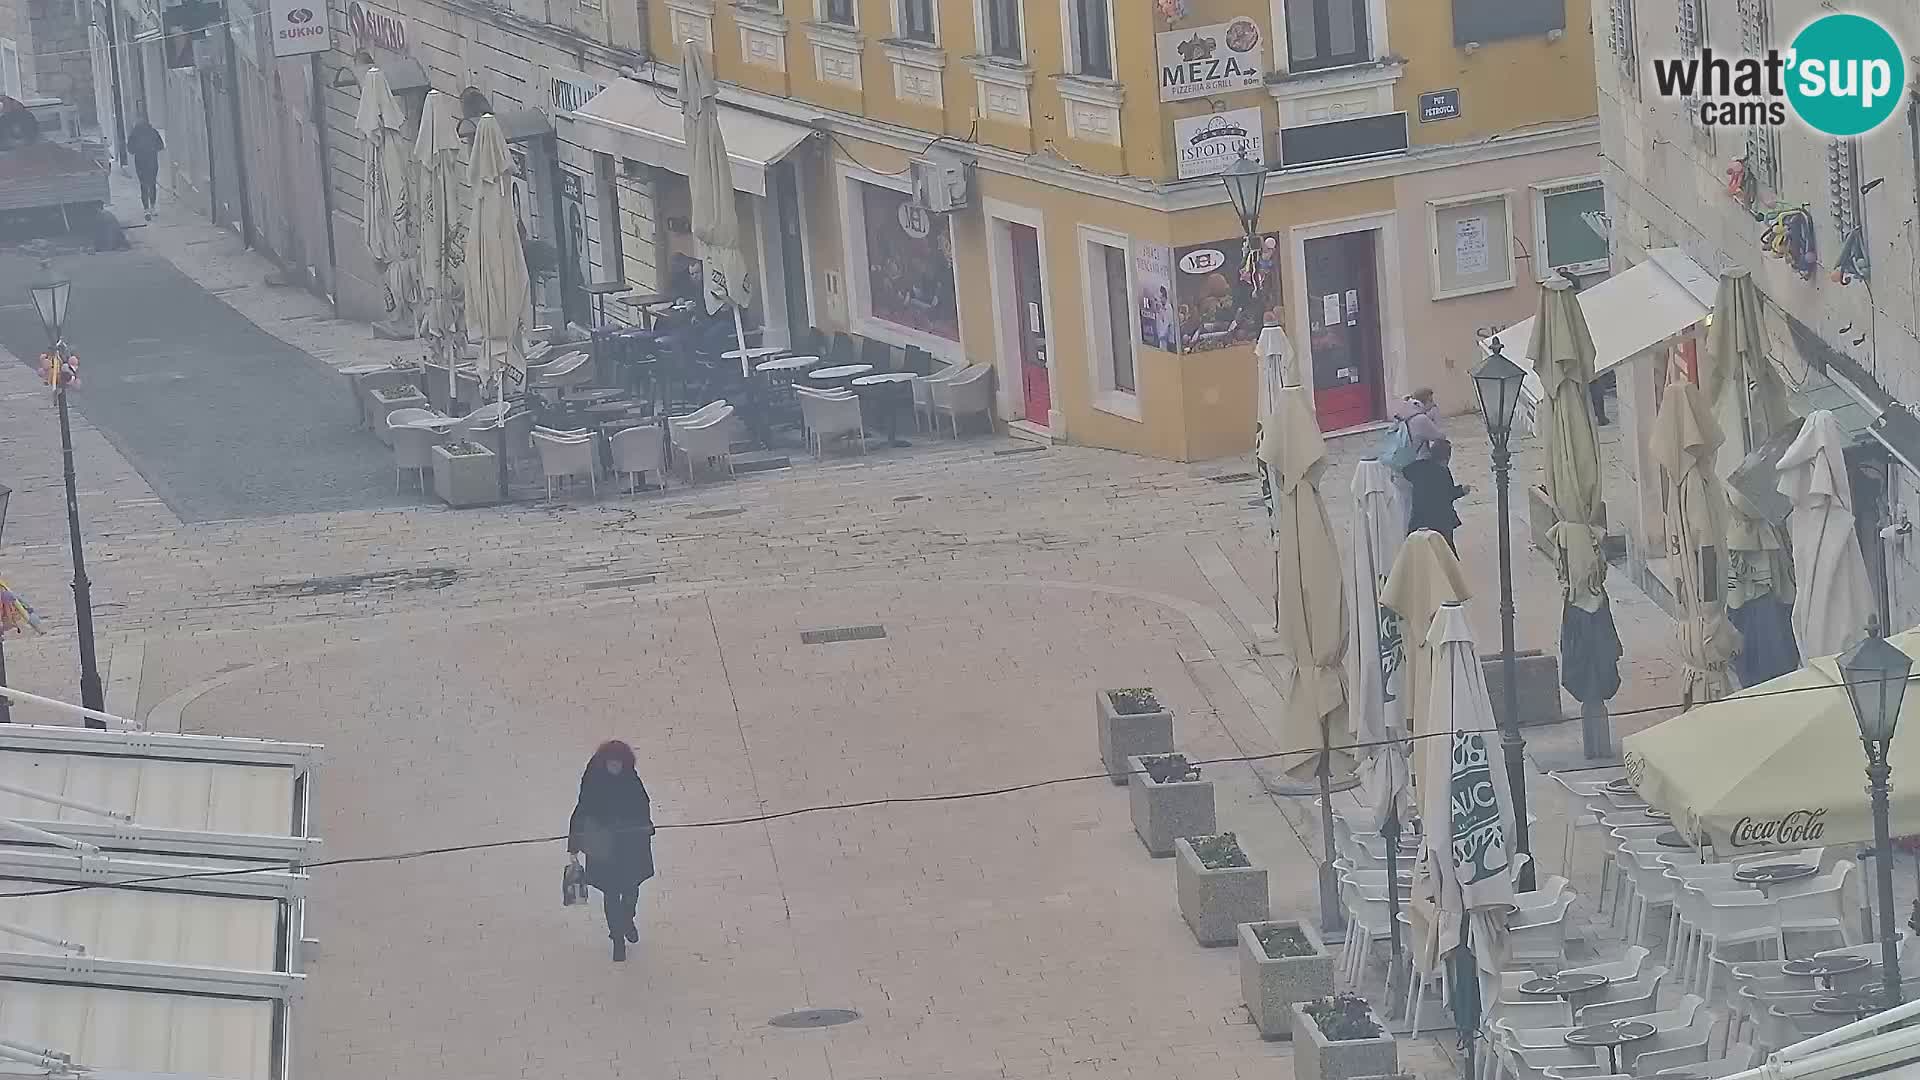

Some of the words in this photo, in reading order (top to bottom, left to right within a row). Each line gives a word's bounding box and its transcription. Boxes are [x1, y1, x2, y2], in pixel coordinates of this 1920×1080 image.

[280, 25, 324, 39] SUKNO
[366, 9, 405, 49] SUKNO
[1163, 57, 1241, 87] MEZA
[1172, 83, 1204, 94] PIZZERIA
[1212, 80, 1232, 89] GRILL
[1433, 96, 1445, 104] PUT
[1425, 105, 1455, 116] PETROVCA
[1181, 142, 1226, 160] ISPOD
[1231, 136, 1260, 153] URE
